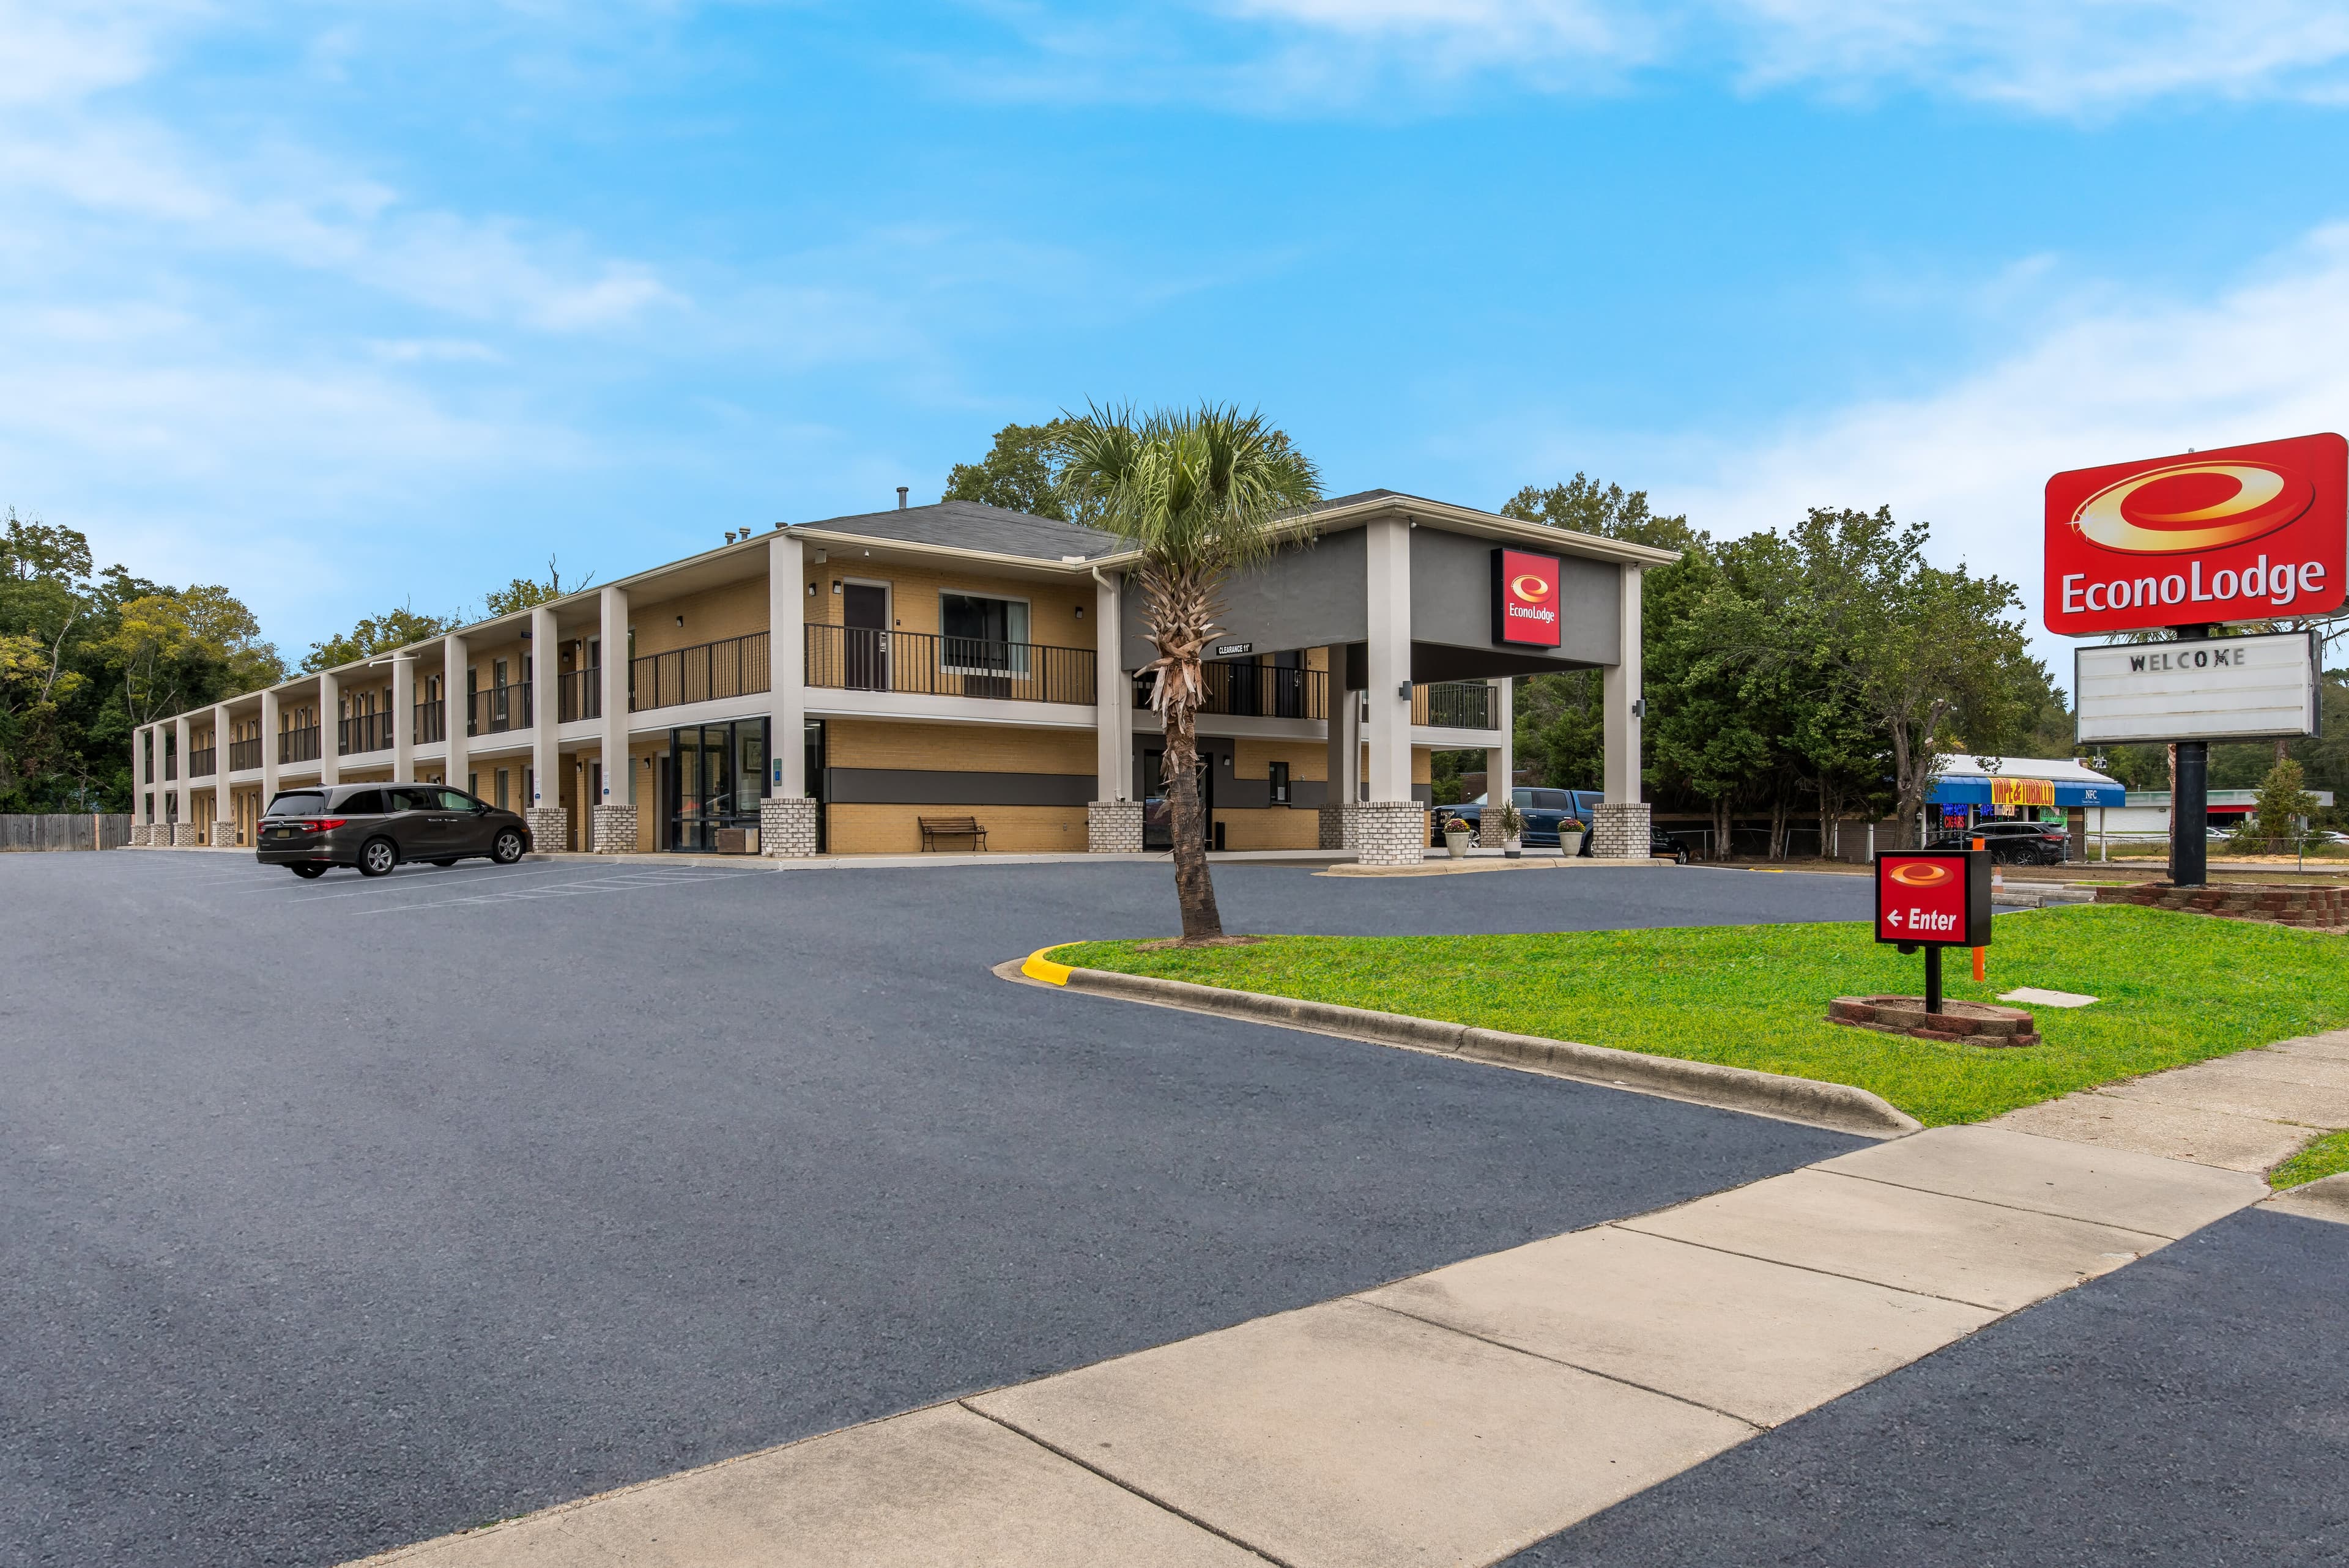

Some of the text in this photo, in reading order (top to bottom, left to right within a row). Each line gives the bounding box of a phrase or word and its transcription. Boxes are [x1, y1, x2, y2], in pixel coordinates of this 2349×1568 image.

[2062, 555, 2325, 613] EconoLodge
[1510, 603, 1554, 623] EconoLodge
[1219, 645, 1243, 654] CLEARANCE
[2129, 648, 2245, 672] WELCOME
[1991, 778, 2013, 804] VAPE
[2013, 781, 2021, 802] &
[2085, 790, 2097, 799] NFC
[1943, 804, 1968, 816] TOBACCO
[1981, 804, 1994, 816] VAPE
[2002, 804, 2015, 816] OPEN
[1944, 816, 1965, 829] CIGARS
[1908, 908, 1957, 931] Enter
